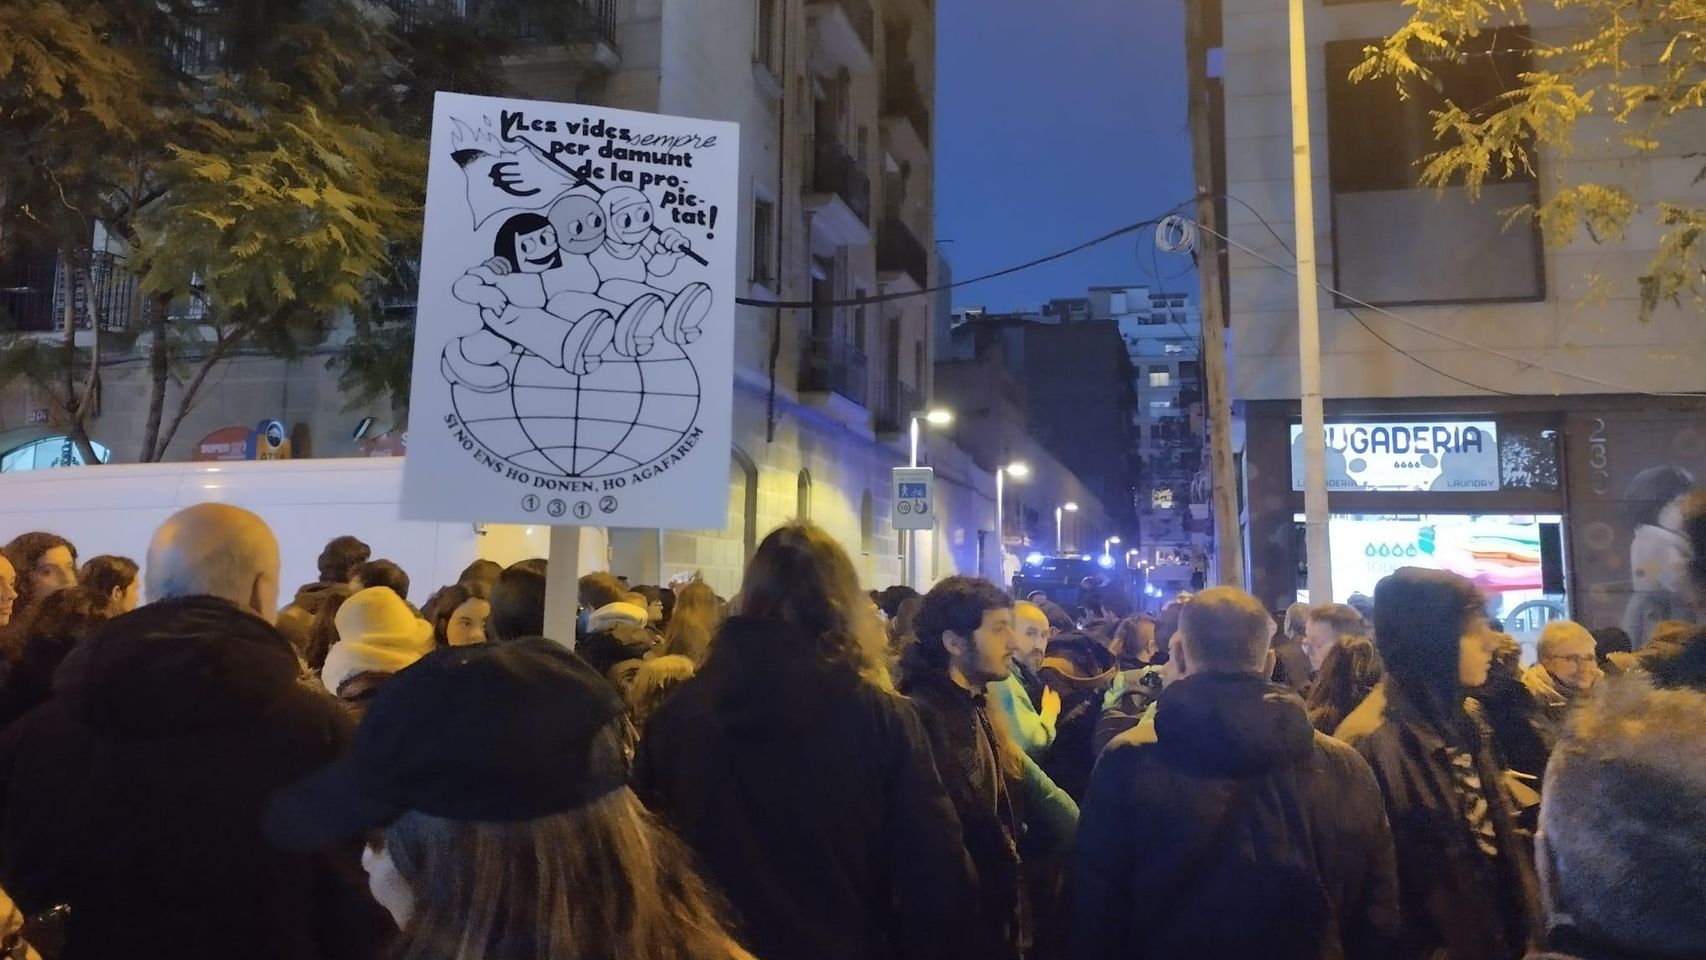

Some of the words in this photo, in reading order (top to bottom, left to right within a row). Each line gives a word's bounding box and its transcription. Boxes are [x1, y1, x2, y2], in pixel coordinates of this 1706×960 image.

[598, 140, 693, 168] damunt
[628, 133, 717, 155] sempre
[611, 162, 633, 183] la
[671, 205, 718, 240] tat!
[444, 413, 458, 429] SI
[453, 429, 474, 450] NO
[473, 449, 505, 473] ENS
[505, 467, 529, 483] HO
[533, 476, 599, 493] DONEN,
[602, 477, 626, 490] HO
[632, 426, 703, 485] AGAFAREM
[1323, 426, 1482, 454] UGADERIA
[1447, 479, 1494, 488] LAUNDRY
